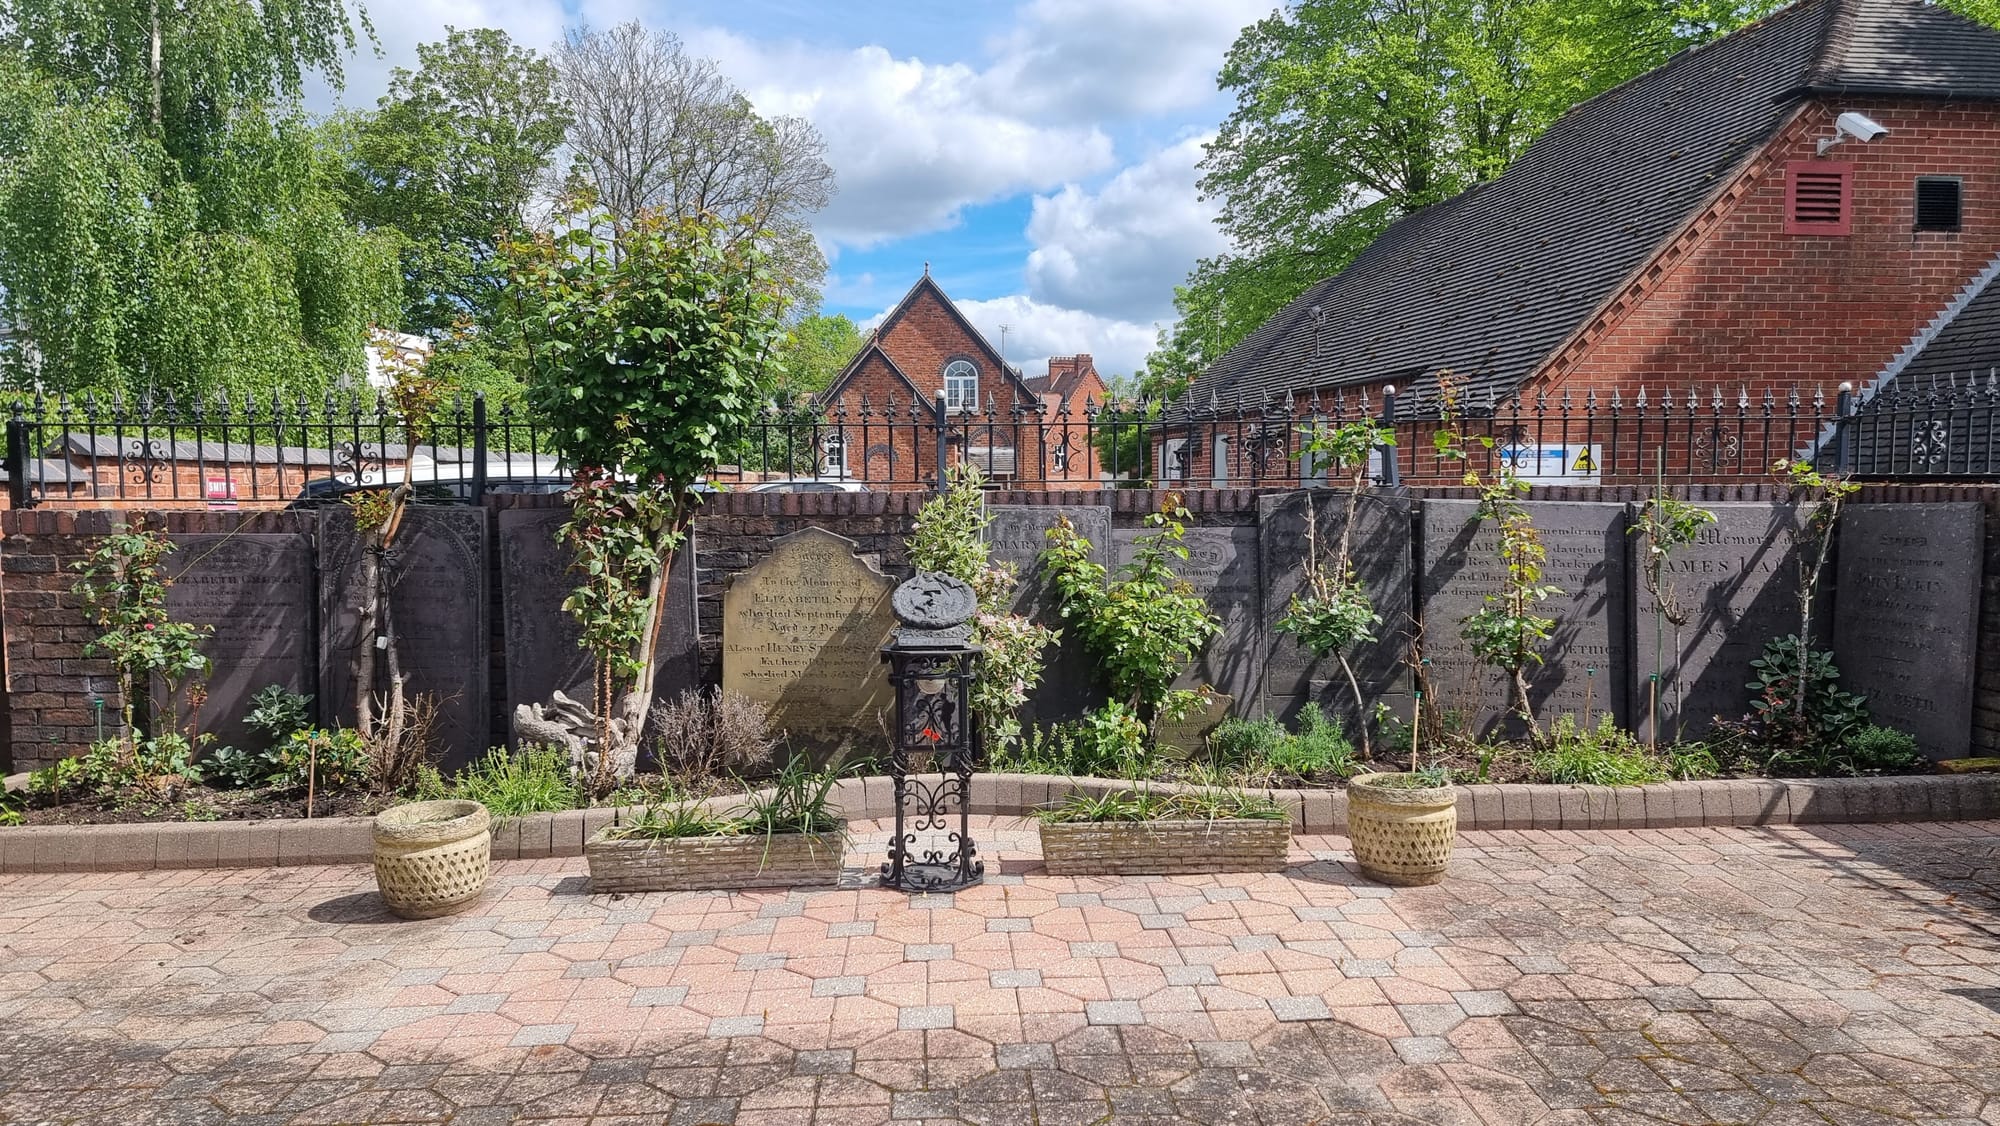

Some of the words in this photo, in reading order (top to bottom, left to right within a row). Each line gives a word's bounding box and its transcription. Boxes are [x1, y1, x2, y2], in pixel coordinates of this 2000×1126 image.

[208, 481, 236, 492] SMITS
[996, 540, 1038, 550] MARY
[1648, 559, 1729, 573] AMES
[1545, 572, 1562, 583] his
[754, 592, 830, 604] ELIZABETH
[739, 608, 764, 619] who
[765, 608, 791, 619] died
[767, 622, 798, 635] Aged
[767, 642, 805, 654] HENRY
[760, 656, 798, 667] Father
